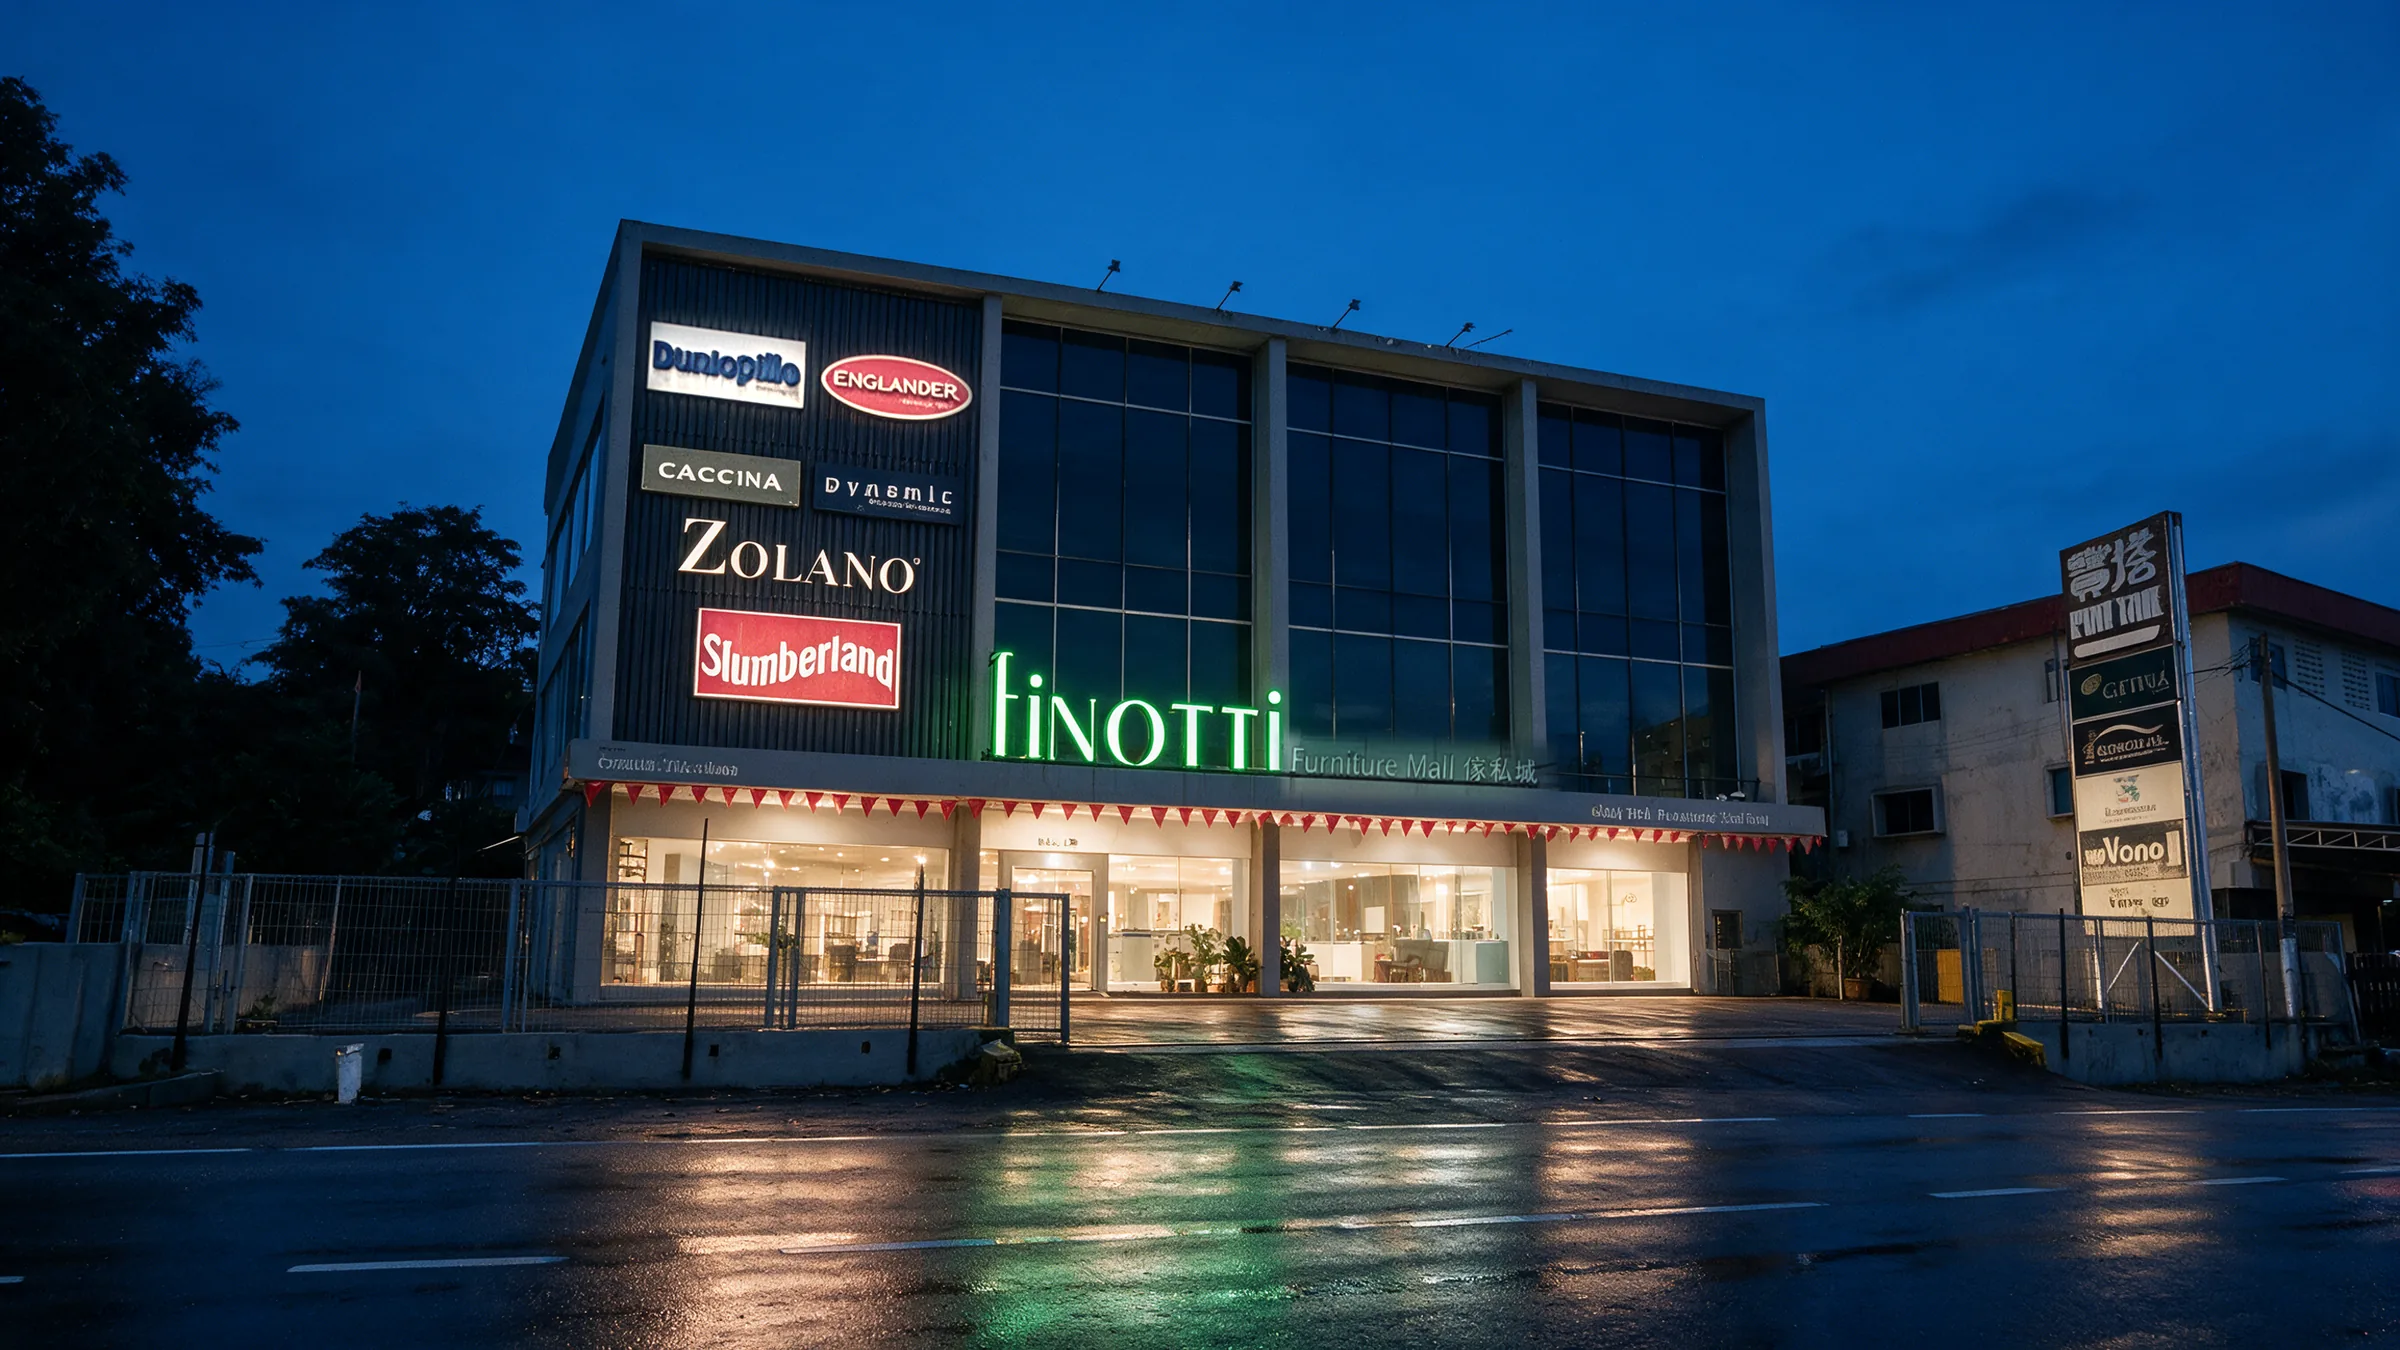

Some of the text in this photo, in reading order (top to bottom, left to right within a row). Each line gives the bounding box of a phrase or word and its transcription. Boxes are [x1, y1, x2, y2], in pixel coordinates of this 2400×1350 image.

[833, 370, 960, 401] ENGLANDER
[658, 462, 782, 491] CACCINA
[678, 518, 915, 594] ZOLANO
[701, 633, 893, 692] Slumberland
[1292, 747, 1538, 784] Furniture Mall 傢私城
[2103, 836, 2165, 864] Vono
